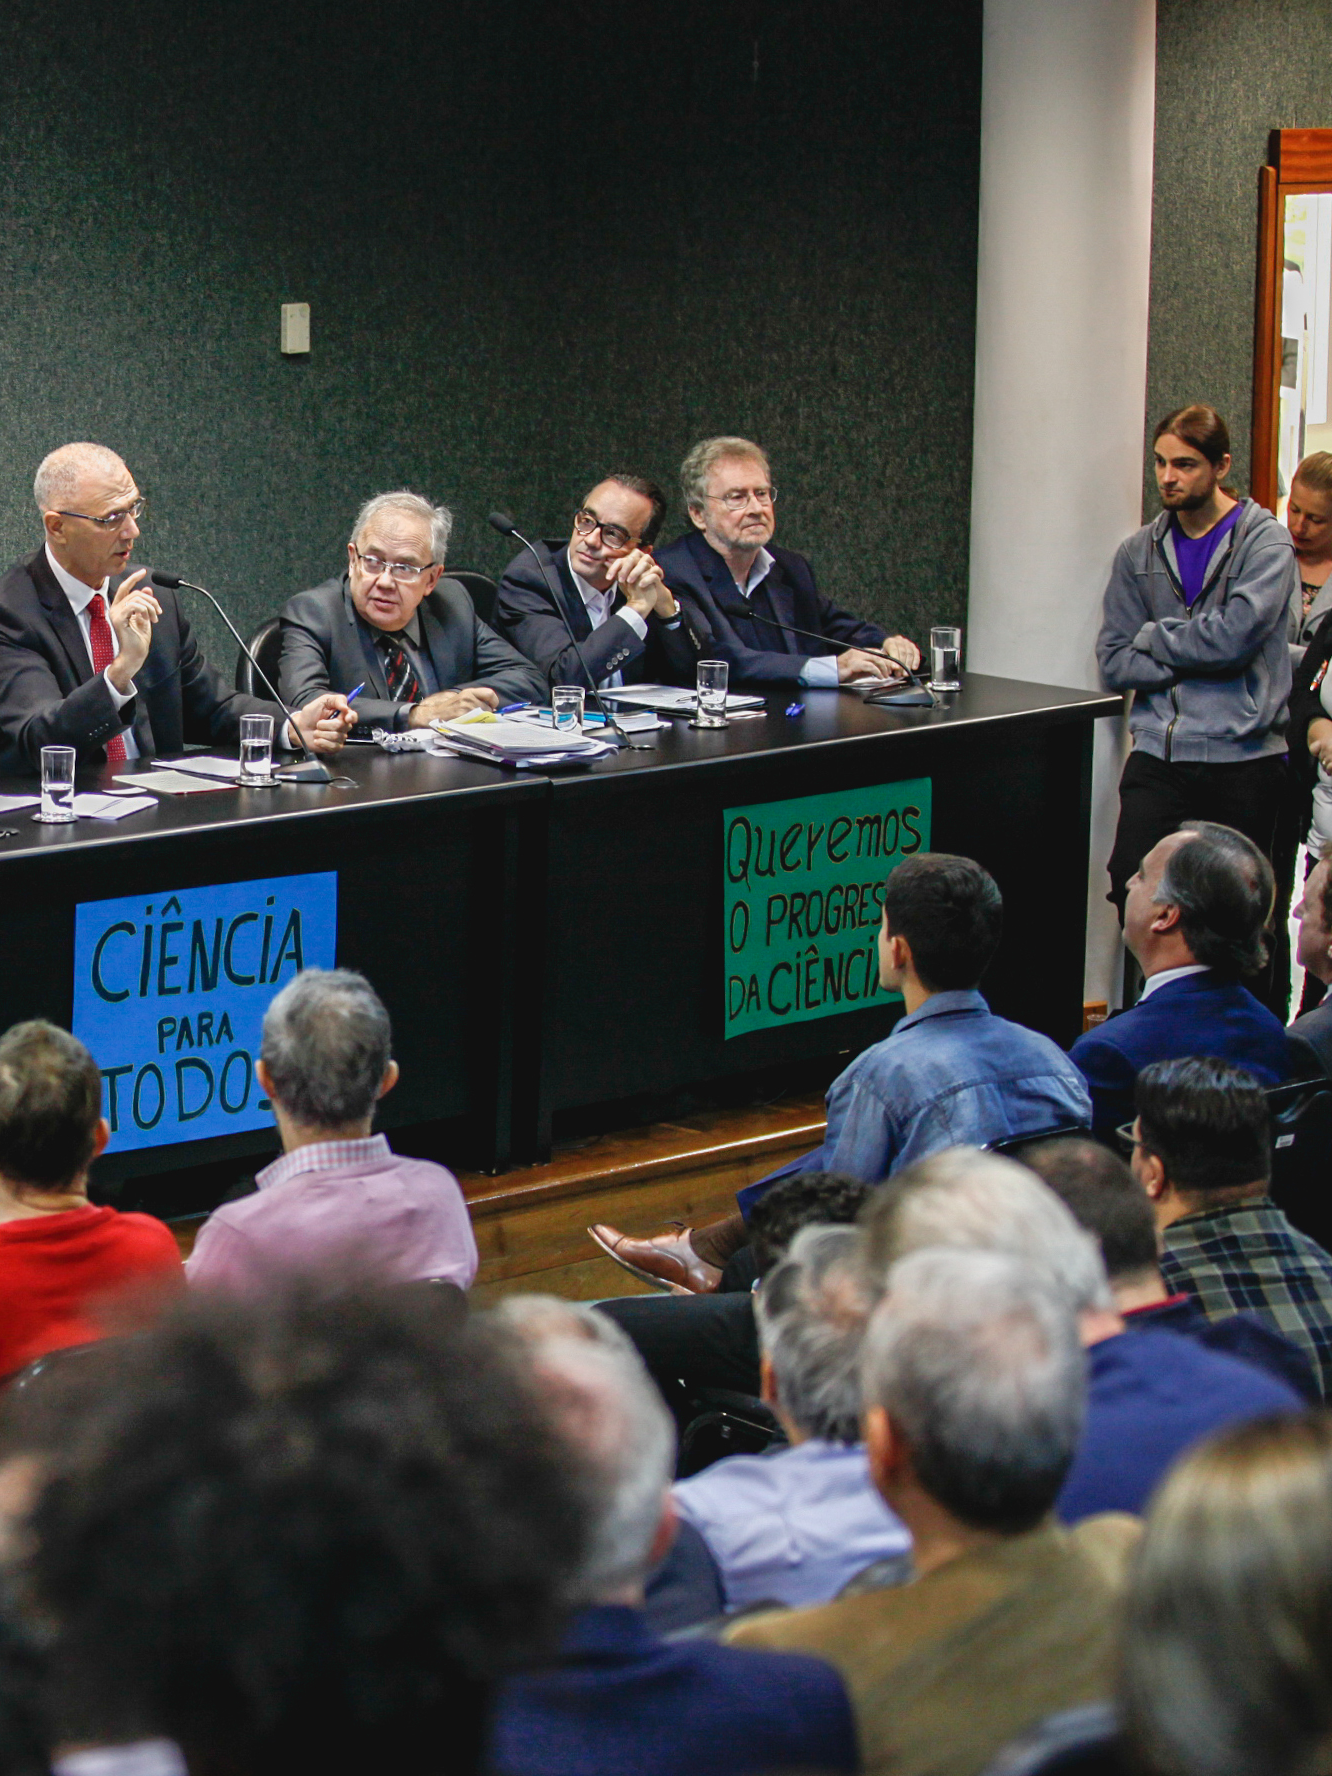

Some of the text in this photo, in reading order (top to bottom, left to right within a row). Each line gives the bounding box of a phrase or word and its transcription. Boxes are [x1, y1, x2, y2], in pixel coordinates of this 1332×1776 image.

[727, 804, 922, 892] Queremos
[729, 881, 886, 954] O PROGRES
[157, 1010, 235, 1054] PARA
[729, 973, 761, 1022] DA
[100, 1049, 273, 1133] TODO
